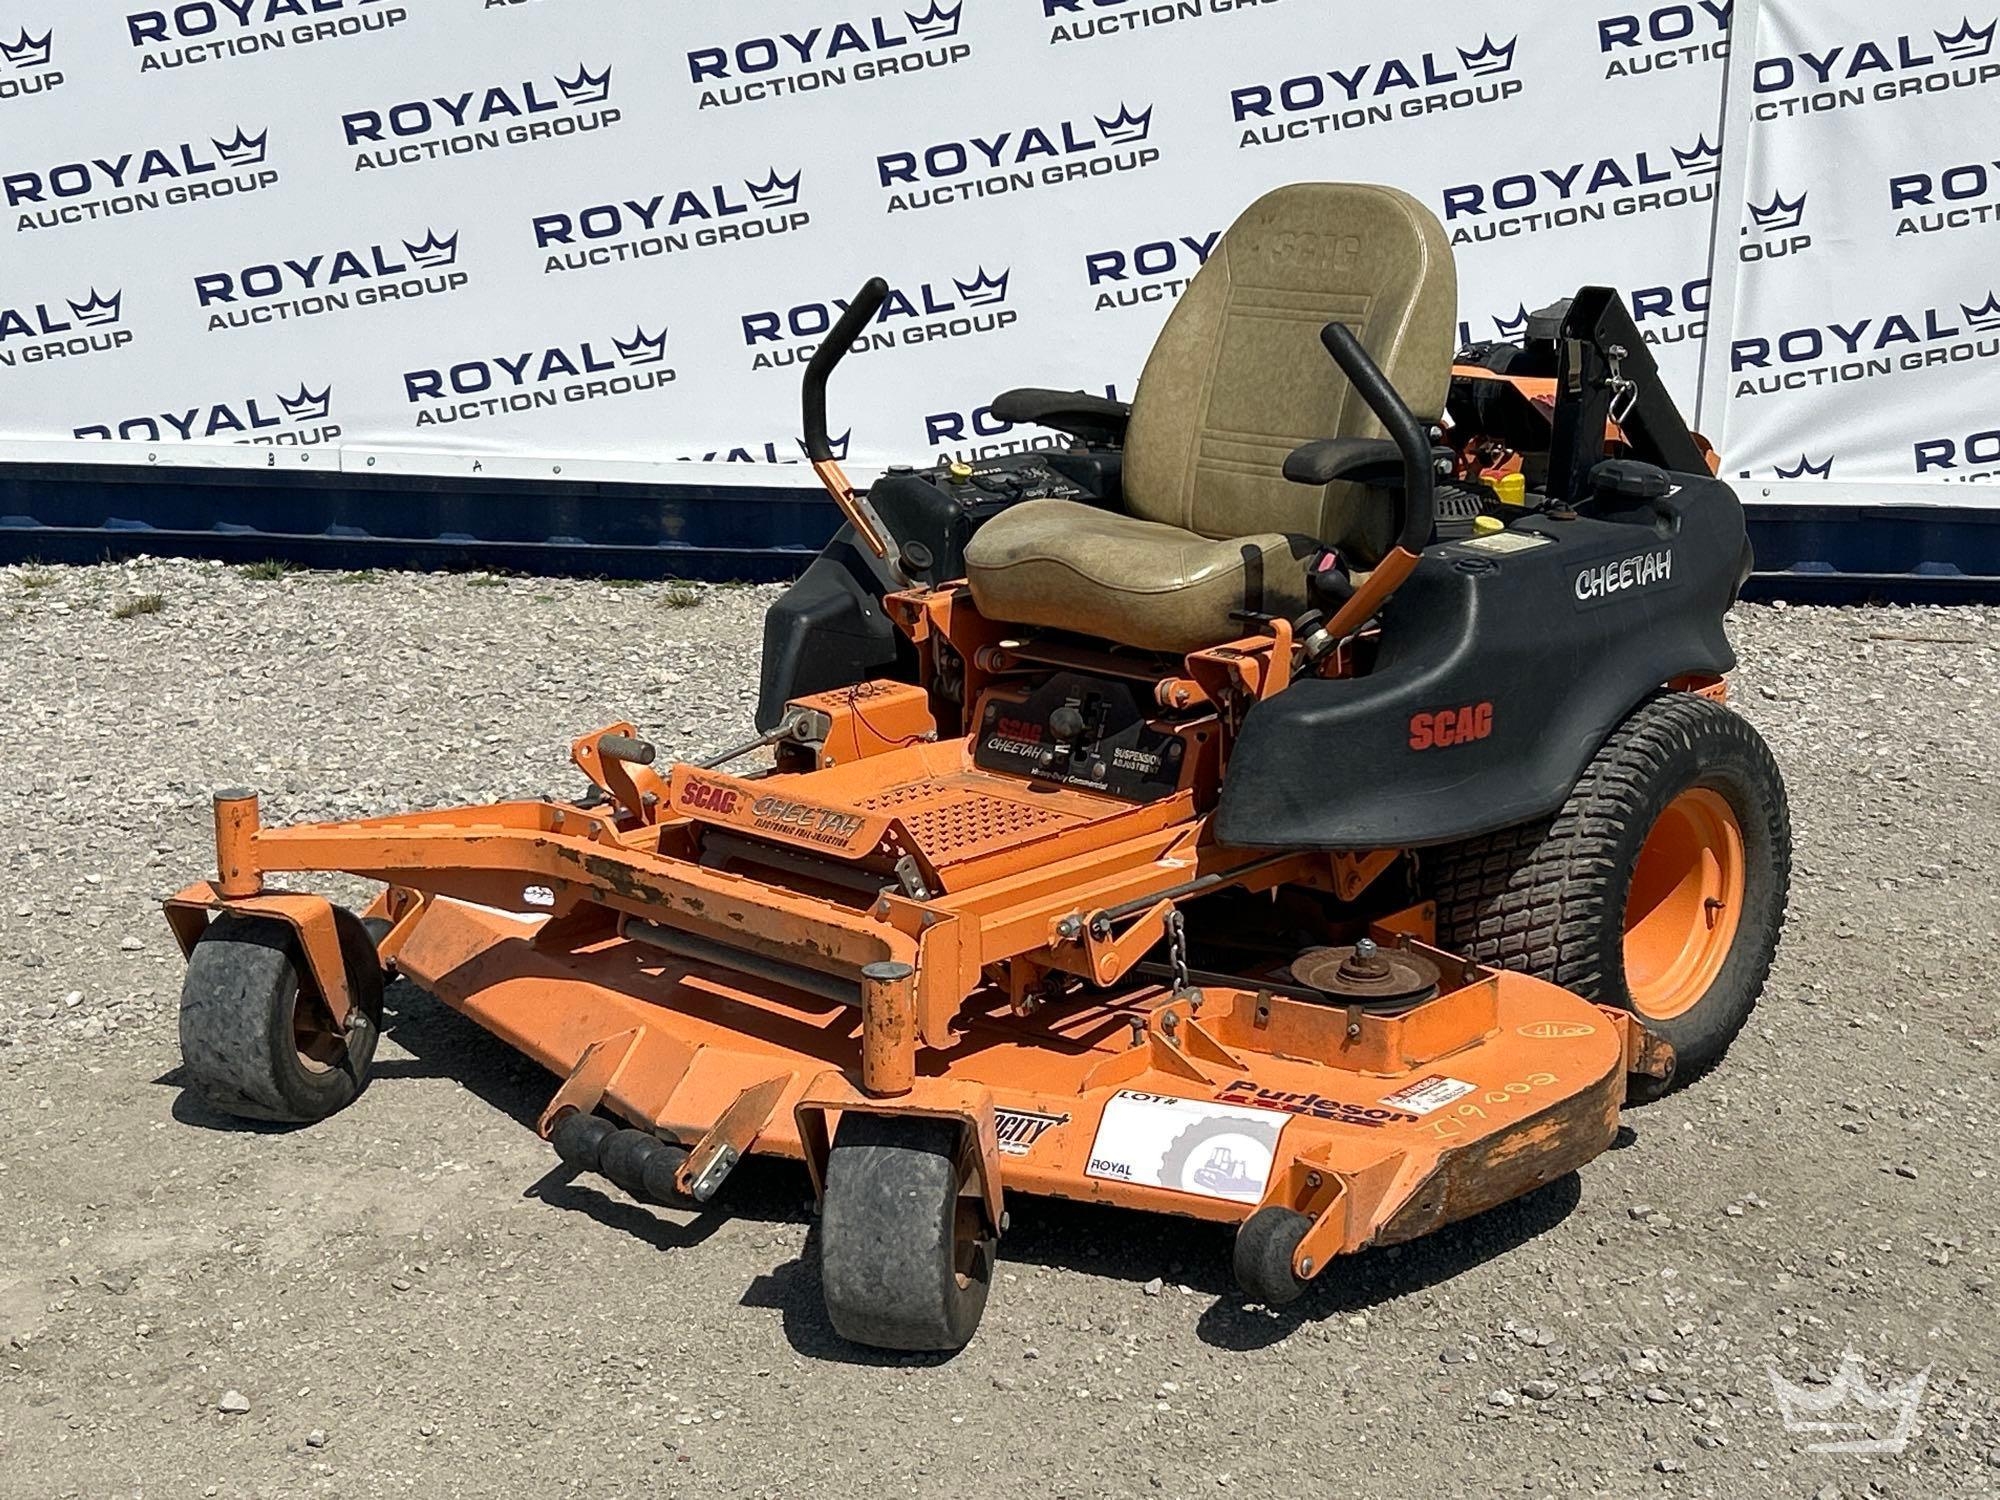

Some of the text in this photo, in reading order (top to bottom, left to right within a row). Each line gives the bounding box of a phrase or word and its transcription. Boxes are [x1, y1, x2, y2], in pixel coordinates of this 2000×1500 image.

[140, 8, 407, 73] AUCTION GROUP
[687, 16, 908, 84] ROYAL
[1049, 3, 1201, 44] AUCTION
[699, 44, 971, 110] AUCTION GROUP
[1230, 52, 1457, 121] ROYAL
[1749, 63, 2000, 122] CTION GROUP
[342, 81, 558, 146] ROYAL
[354, 108, 622, 172] AUCTION GROUP
[1240, 79, 1523, 148] AUCTION GROUP
[2, 143, 216, 207] ROYAL
[876, 120, 1097, 187] ROYAL
[887, 148, 1160, 213] AUCTION GROUP
[16, 169, 279, 232] AUCTION GROUP
[532, 184, 748, 249] ROYAL
[1443, 152, 1671, 220] ROYAL
[544, 212, 810, 273] AUCTION GROUP
[1450, 203, 1605, 246] AUCTION
[195, 245, 406, 306] ROYAL
[207, 271, 469, 332] AUCTION GROUP
[22, 330, 133, 364] GROUP
[751, 310, 1017, 371] AUCON GROUP
[1731, 309, 1959, 372] ROYAL
[404, 342, 615, 403] ROYAL
[416, 368, 677, 428] AUCTION GROUP
[1735, 357, 1891, 399] AUCTION
[1575, 549, 1672, 600] CHEETAH
[987, 738, 1043, 760] CHEETAH
[1114, 747, 1162, 766] SUSPENSION
[1409, 702, 1494, 752] SCAG
[681, 781, 738, 814] SCAG
[752, 796, 866, 838] CHEETAH
[1119, 1091, 1179, 1105] LOT#
[1091, 1159, 1133, 1176] ROYAL
